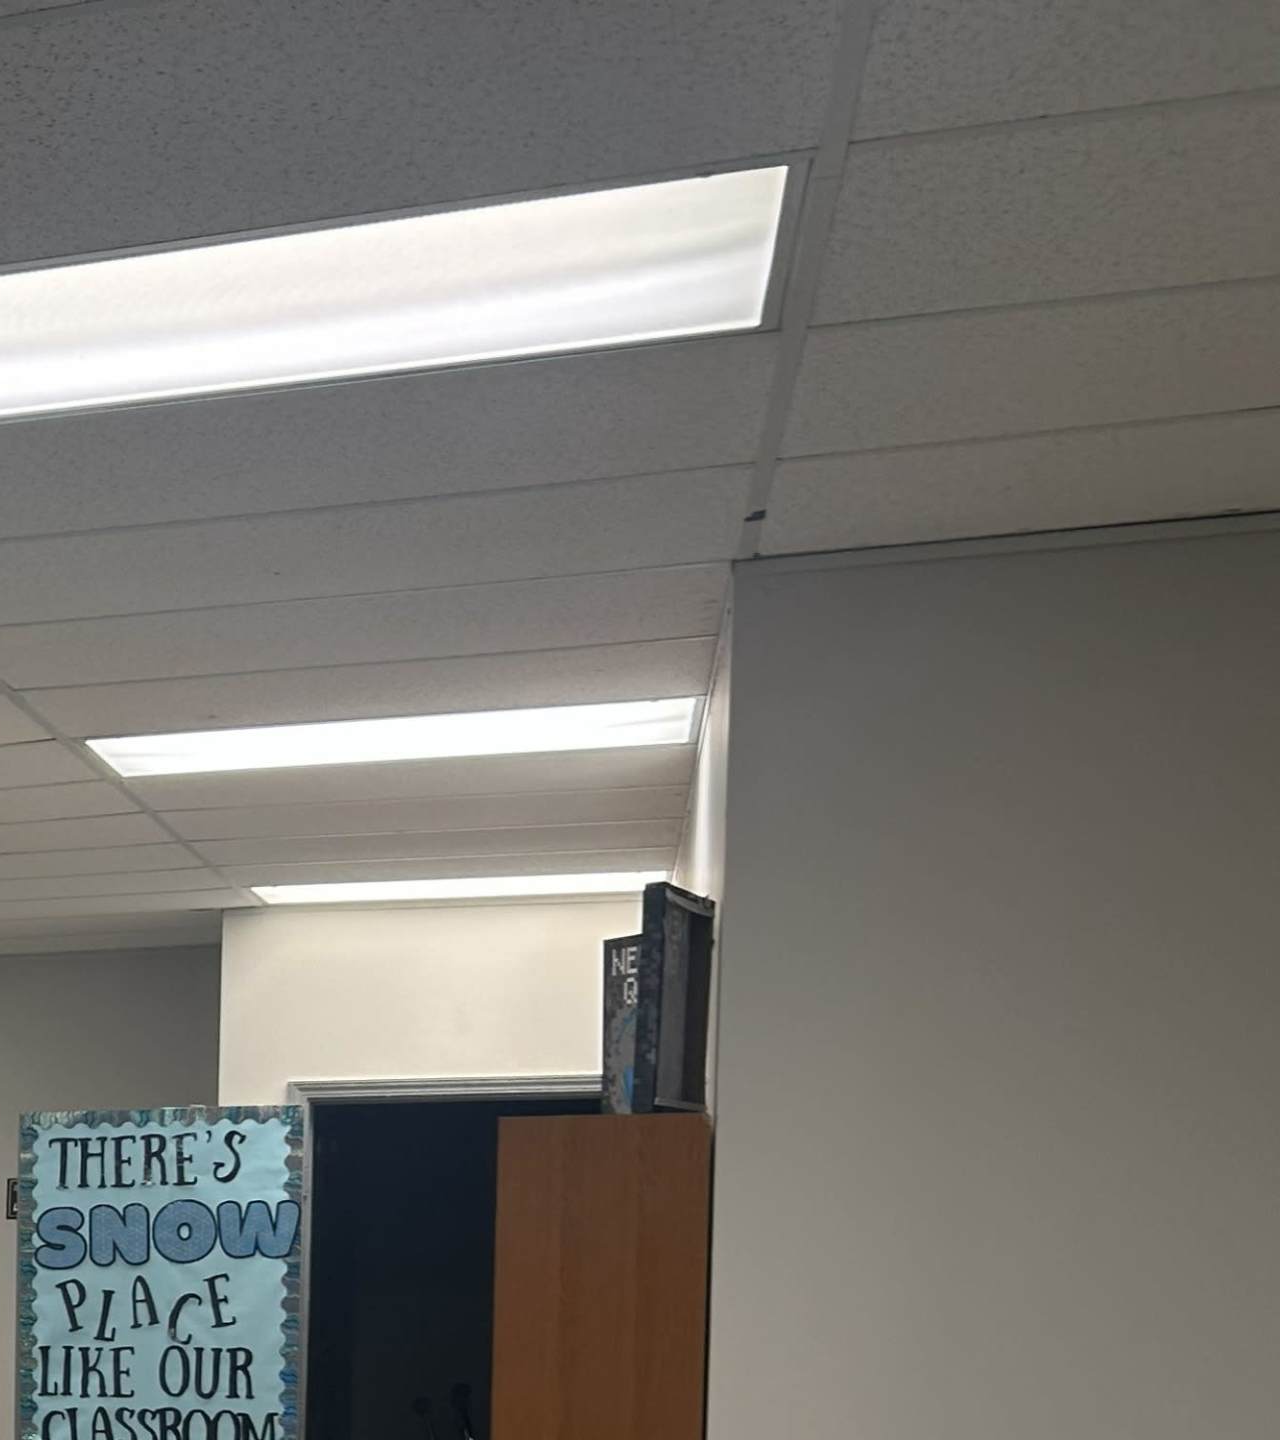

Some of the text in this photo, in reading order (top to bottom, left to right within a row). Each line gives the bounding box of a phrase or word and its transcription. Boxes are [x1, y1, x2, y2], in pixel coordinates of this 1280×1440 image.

[48, 1130, 246, 1191] THERE'S
[34, 1199, 301, 1271] SNOW
[56, 1273, 236, 1345] PLACE
[38, 1345, 255, 1400] LIKE OUR
